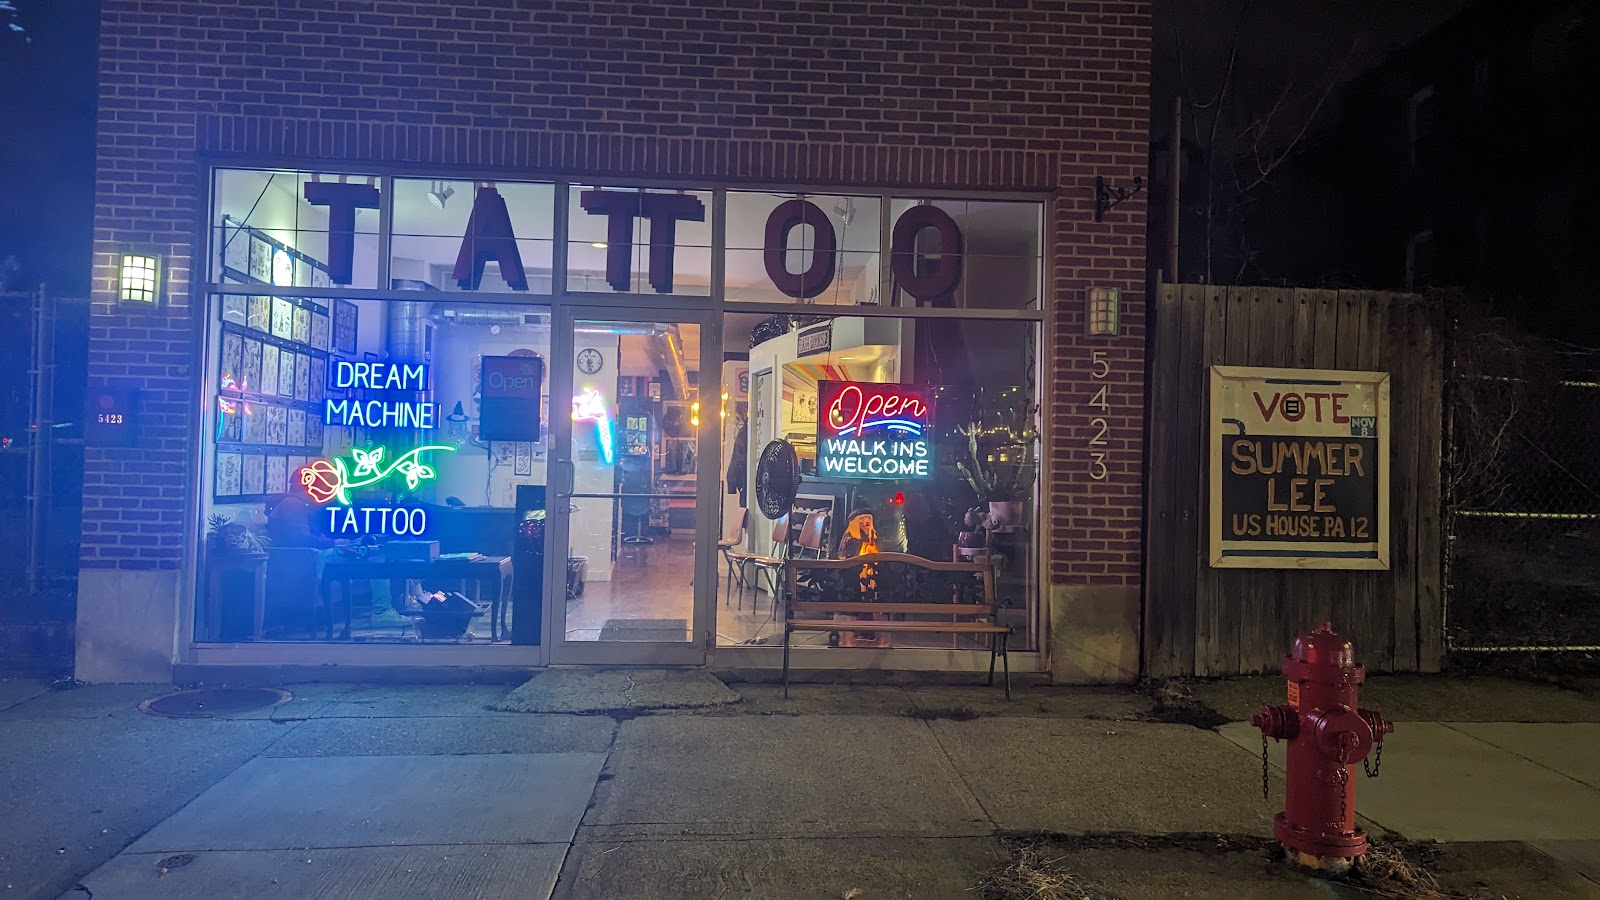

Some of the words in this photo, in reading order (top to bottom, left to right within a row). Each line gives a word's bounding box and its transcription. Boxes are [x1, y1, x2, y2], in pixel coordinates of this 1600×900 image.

[304, 181, 964, 300] TATTOO
[337, 361, 423, 390] DREAM
[488, 371, 534, 392] Open
[98, 413, 123, 424] 5423
[326, 399, 434, 429] MACHINE
[829, 386, 926, 436] Open
[1089, 352, 1109, 479] 5423
[1253, 391, 1350, 424] VOTE
[1351, 417, 1376, 428] NOV
[1360, 427, 1369, 437] 8
[827, 438, 887, 456] WALK
[893, 441, 928, 457] INS
[1231, 439, 1365, 477] SUMMER
[824, 456, 929, 476] WELCOME
[1267, 478, 1336, 513] LEE
[326, 506, 426, 536] TATTOO
[1232, 513, 1262, 537] US
[1265, 514, 1320, 537] HOUSE
[1324, 516, 1346, 538] PA
[1350, 516, 1369, 538] 12
